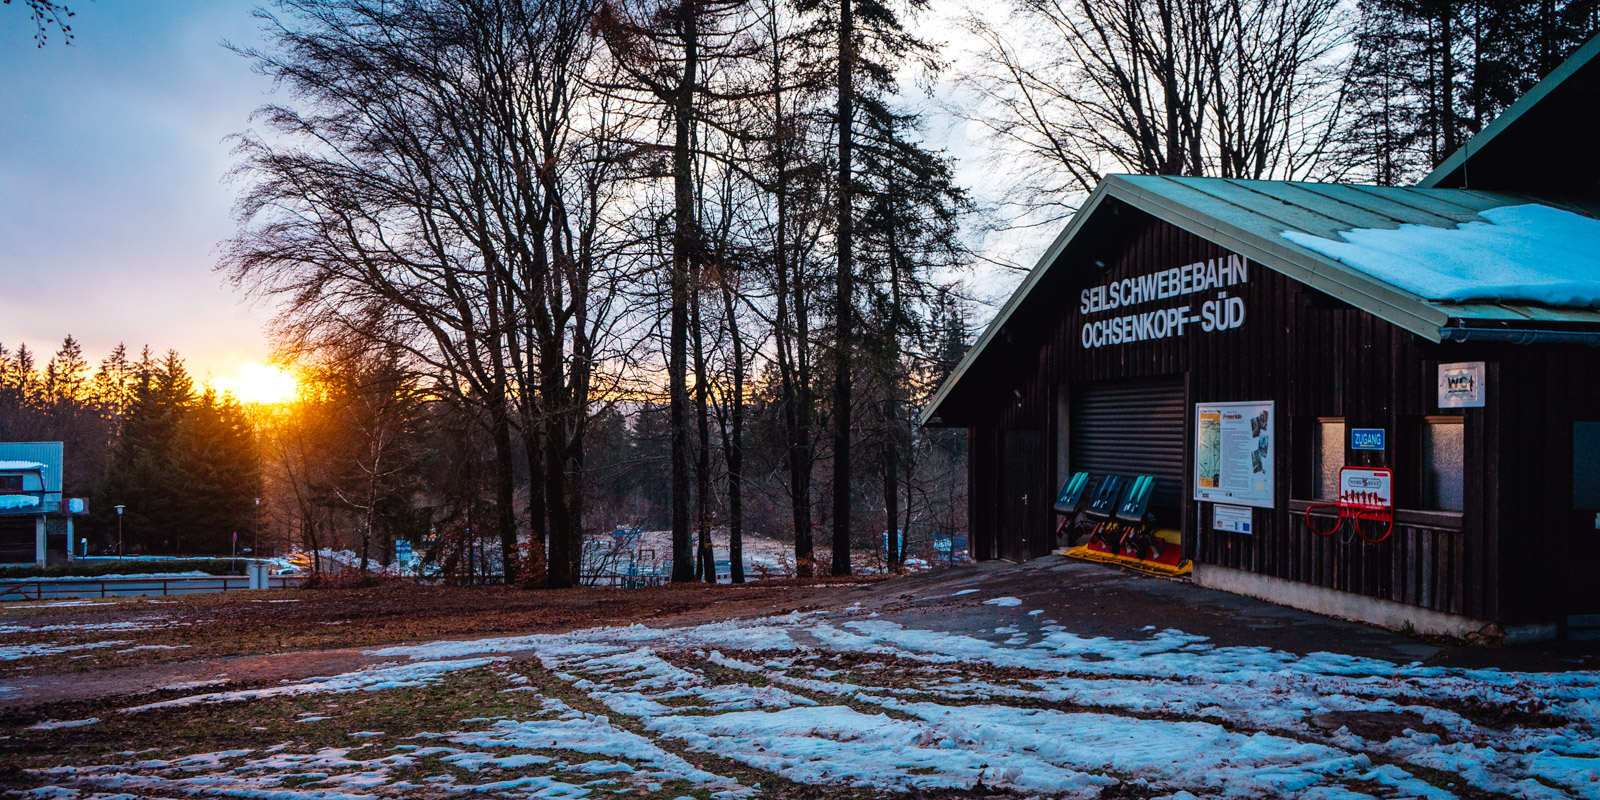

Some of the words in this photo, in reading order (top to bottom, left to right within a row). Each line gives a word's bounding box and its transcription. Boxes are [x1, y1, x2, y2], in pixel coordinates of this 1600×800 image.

[1080, 254, 1248, 315] SEILSCHWEBEBAHN
[1082, 292, 1245, 349] OCHSENKOPF-SÜD
[1448, 376, 1468, 389] WC
[1355, 433, 1382, 445] ZUGANG
